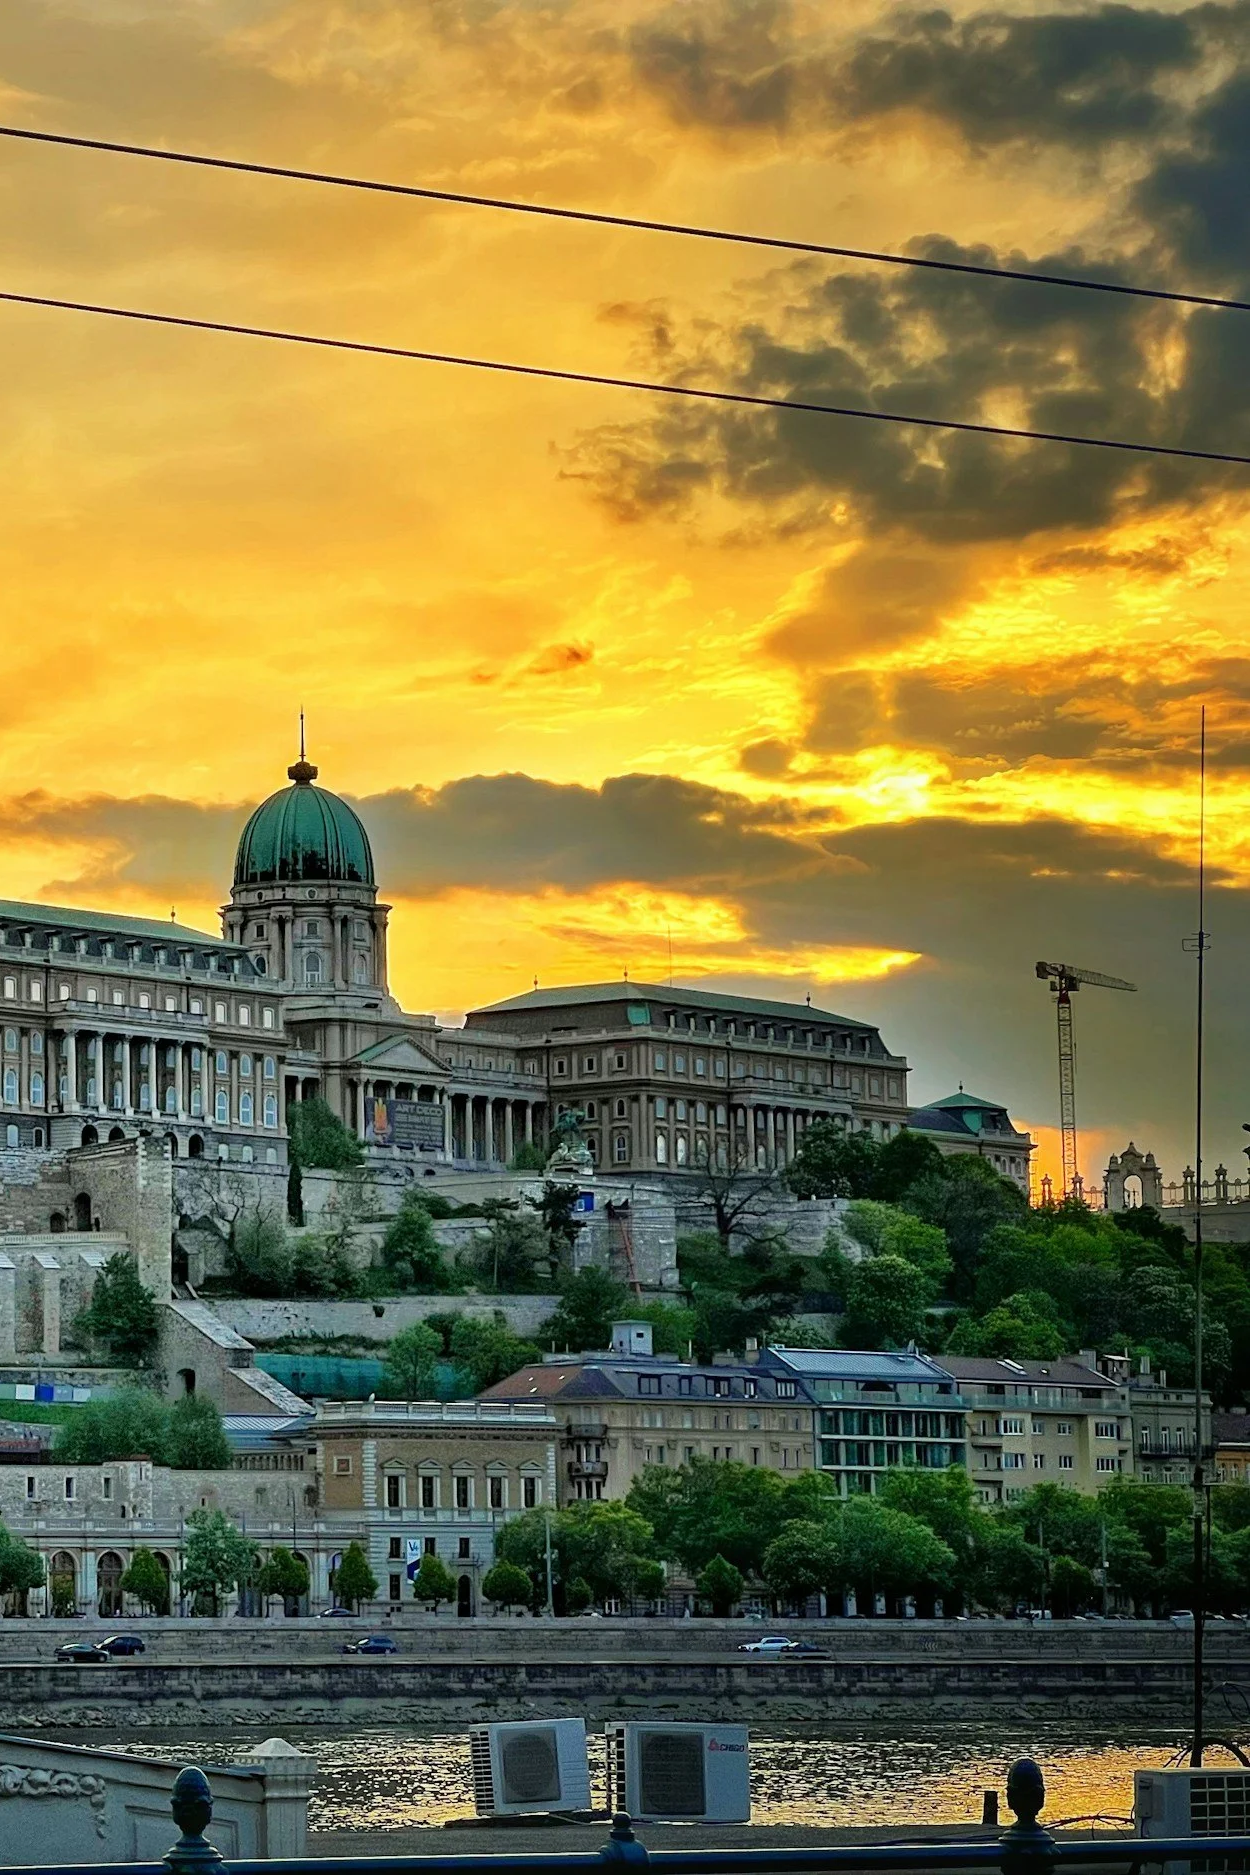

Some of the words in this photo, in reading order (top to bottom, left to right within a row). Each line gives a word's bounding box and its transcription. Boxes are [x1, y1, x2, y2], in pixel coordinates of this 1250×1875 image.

[395, 1104, 416, 1114] ART
[416, 1106, 443, 1117] DECO
[720, 1743, 745, 1753] CHIGO
